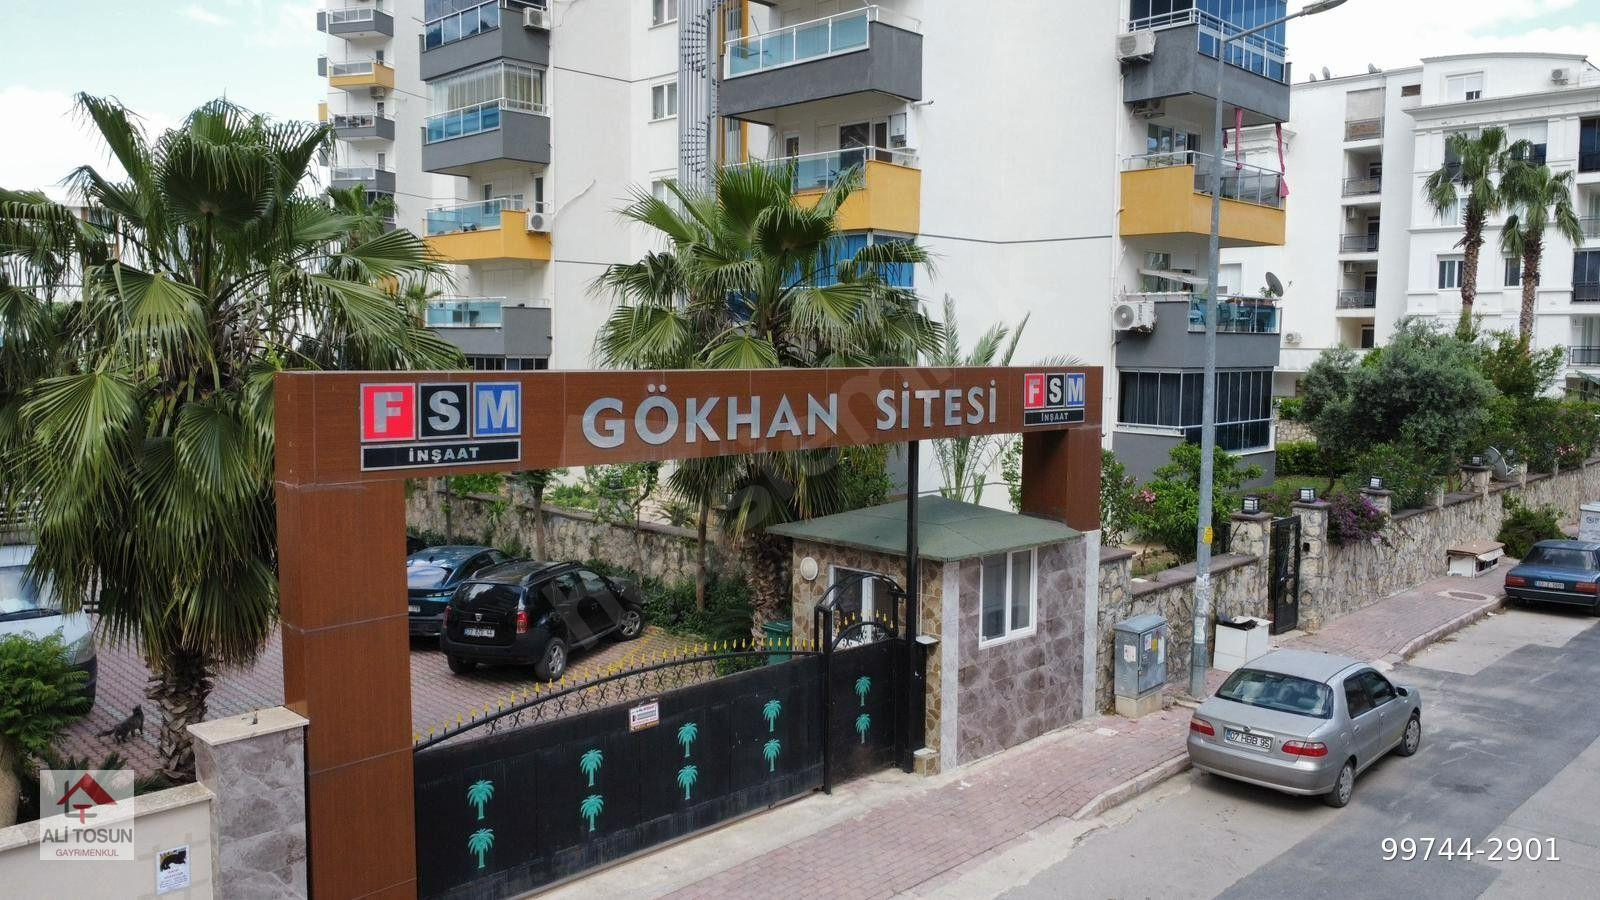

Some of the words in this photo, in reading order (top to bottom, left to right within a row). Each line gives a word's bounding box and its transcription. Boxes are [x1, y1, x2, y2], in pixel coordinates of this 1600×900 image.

[1028, 377, 1083, 404] FSM
[373, 389, 516, 433] FSM
[582, 383, 838, 449] GÖKHAN
[409, 447, 480, 464] İNŞAAT
